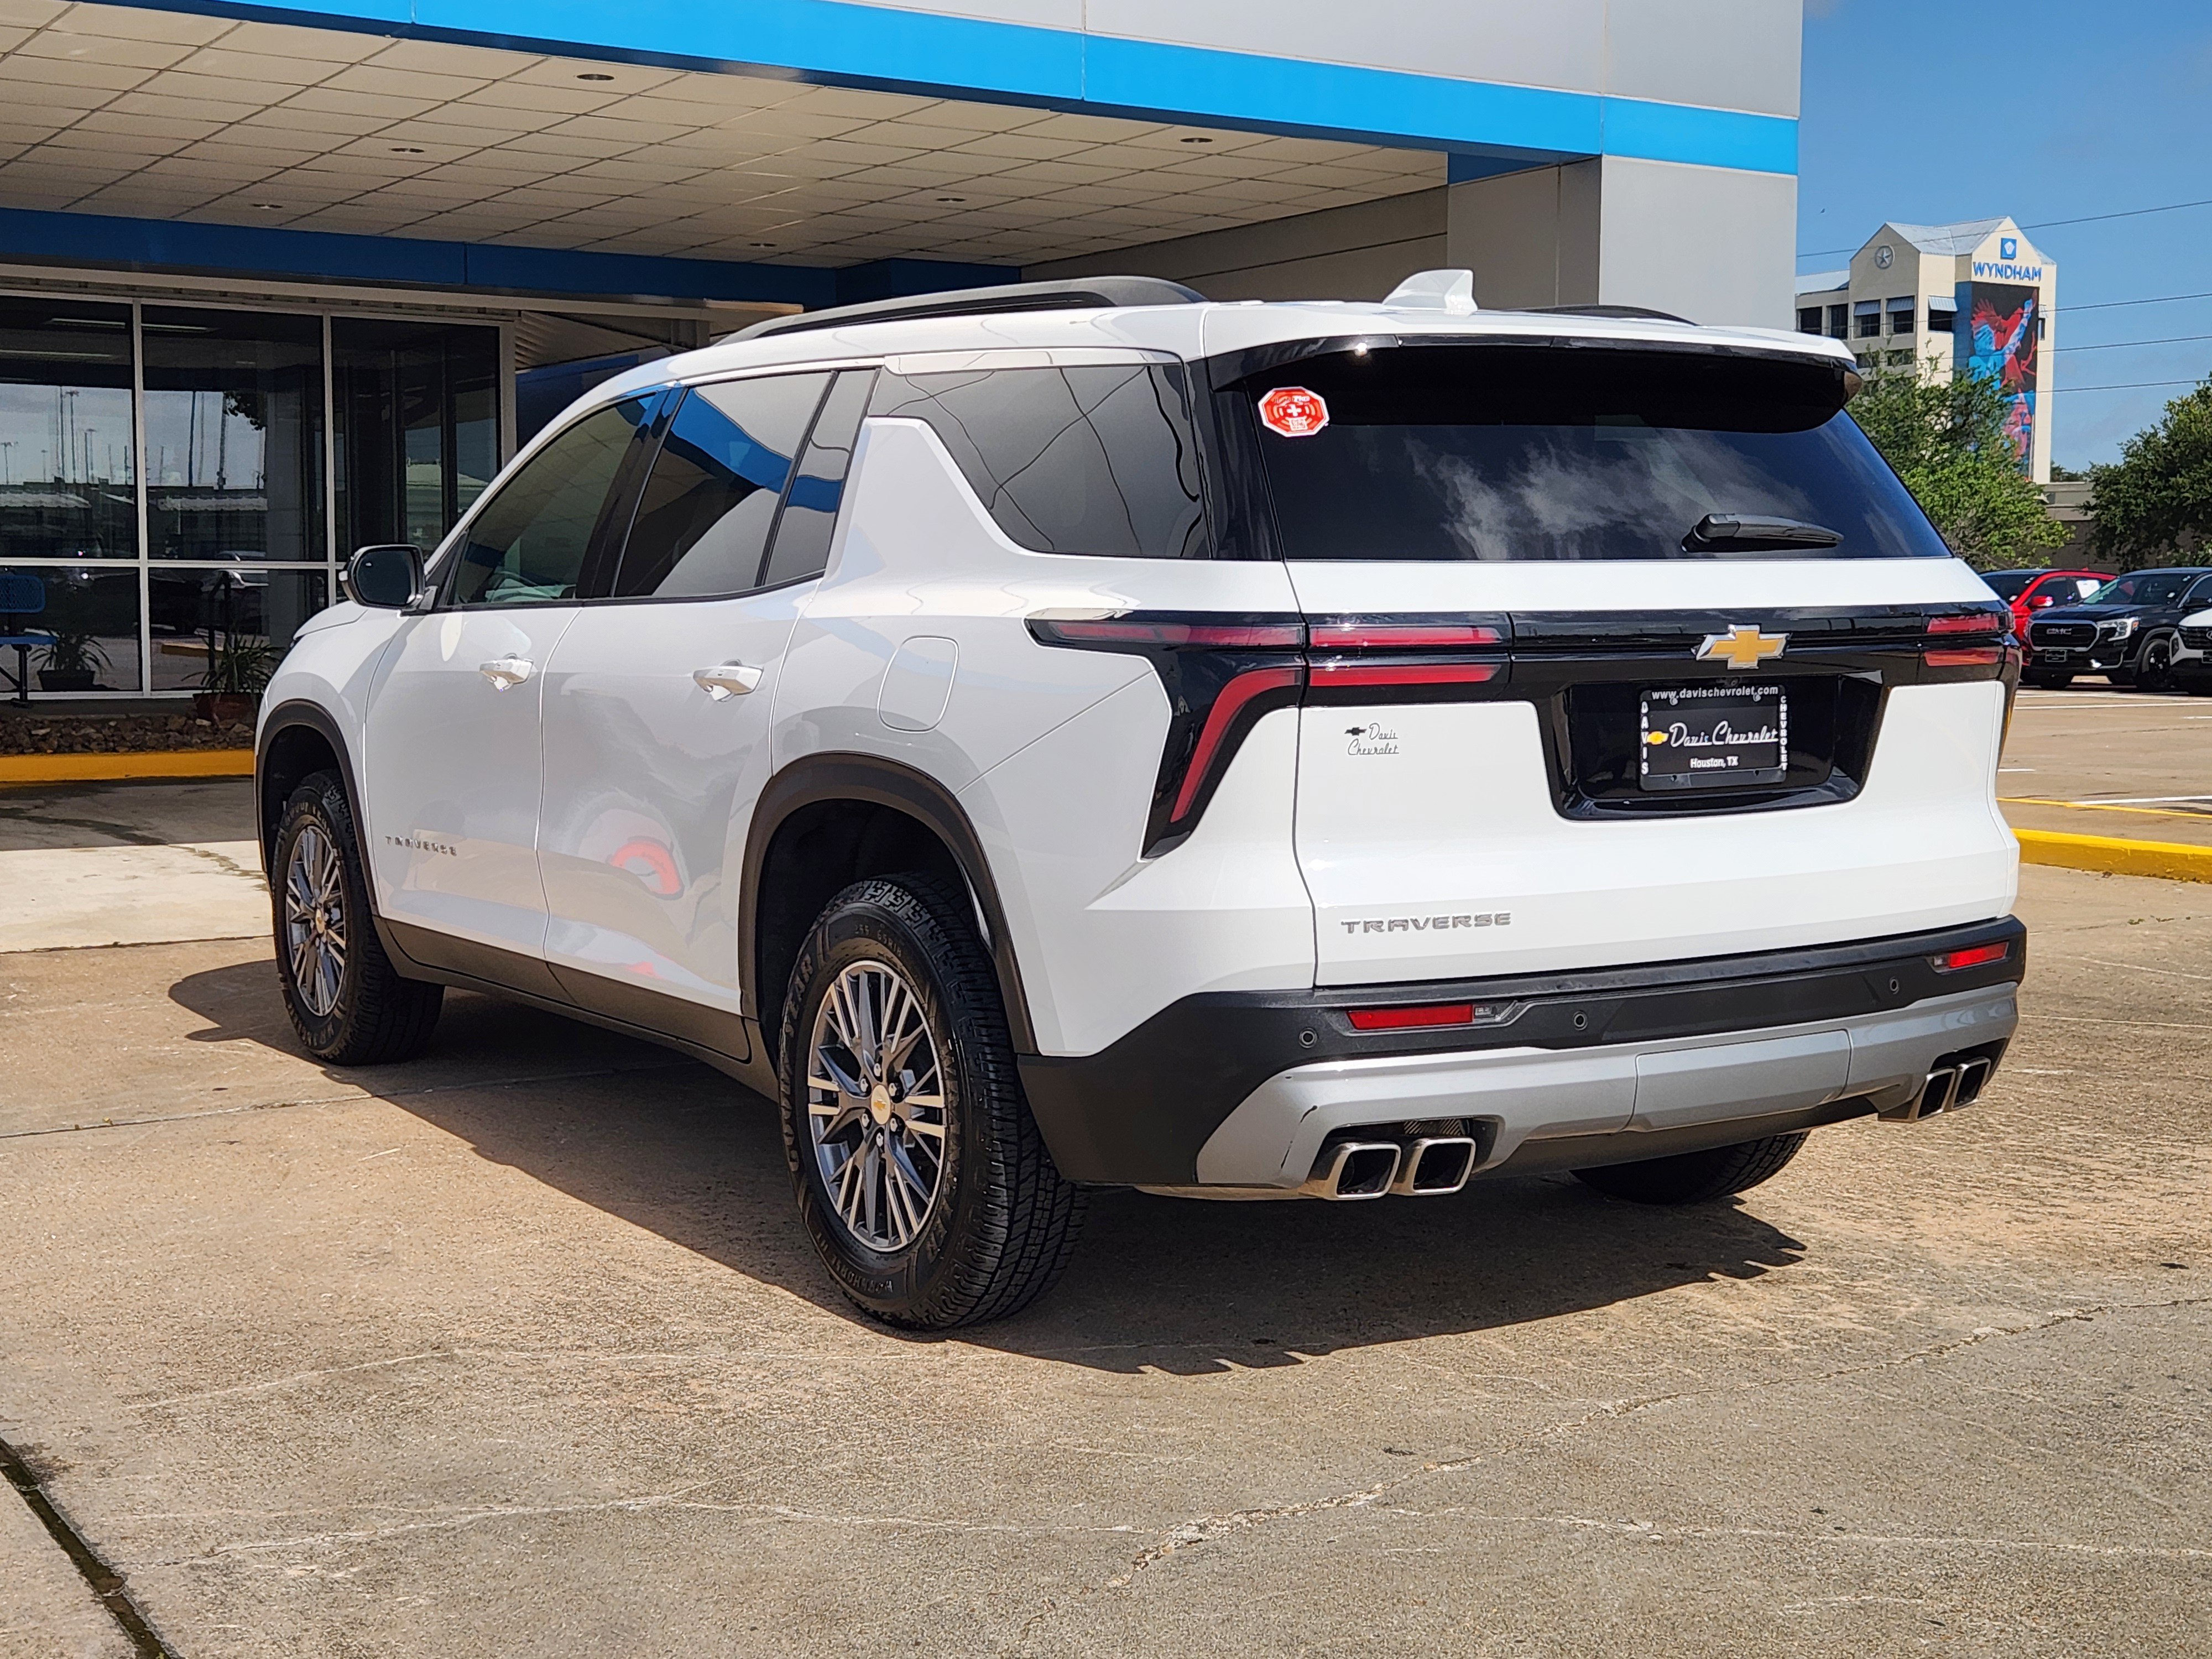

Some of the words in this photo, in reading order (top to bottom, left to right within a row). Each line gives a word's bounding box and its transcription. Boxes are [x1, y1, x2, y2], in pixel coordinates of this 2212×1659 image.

[1973, 262, 2042, 282] WYNDHAM
[1651, 686, 1778, 700] www.davischevrolet.com
[1369, 722, 1399, 740] Davis
[1641, 701, 1649, 775] DAVIS
[1669, 722, 1712, 748] Davis
[1712, 720, 1779, 745] Chevrolet
[1780, 695, 1788, 771] CHEVROLET
[1347, 738, 1400, 756] Chevrolet
[1690, 757, 1726, 769] Houston,
[1727, 756, 1739, 766] TX
[385, 835, 457, 857] TRAVERSE
[1341, 912, 1511, 934] TRAVERSE
